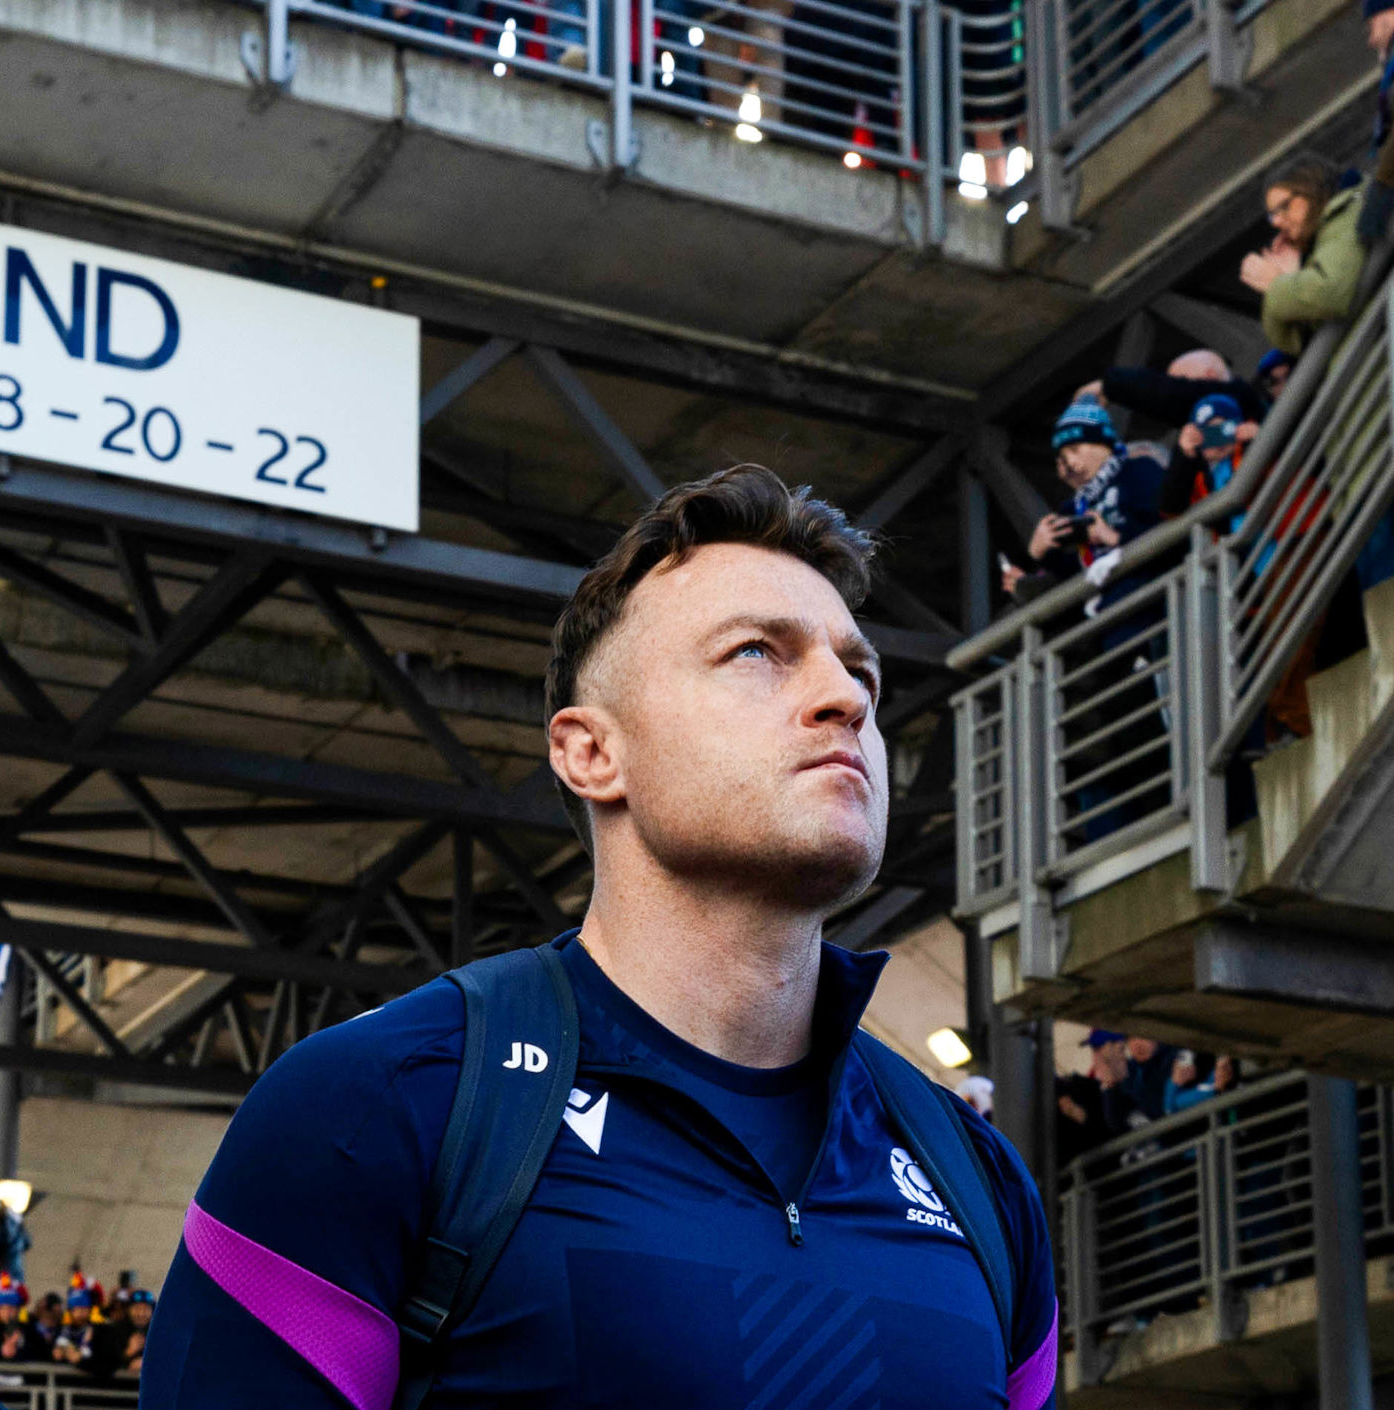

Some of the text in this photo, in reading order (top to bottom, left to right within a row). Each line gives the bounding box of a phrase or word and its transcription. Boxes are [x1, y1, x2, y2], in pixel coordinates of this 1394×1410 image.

[101, 397, 182, 463] 20
[256, 429, 328, 494] 22
[502, 1041, 549, 1073] JD
[906, 1207, 965, 1238] SCOTLA
